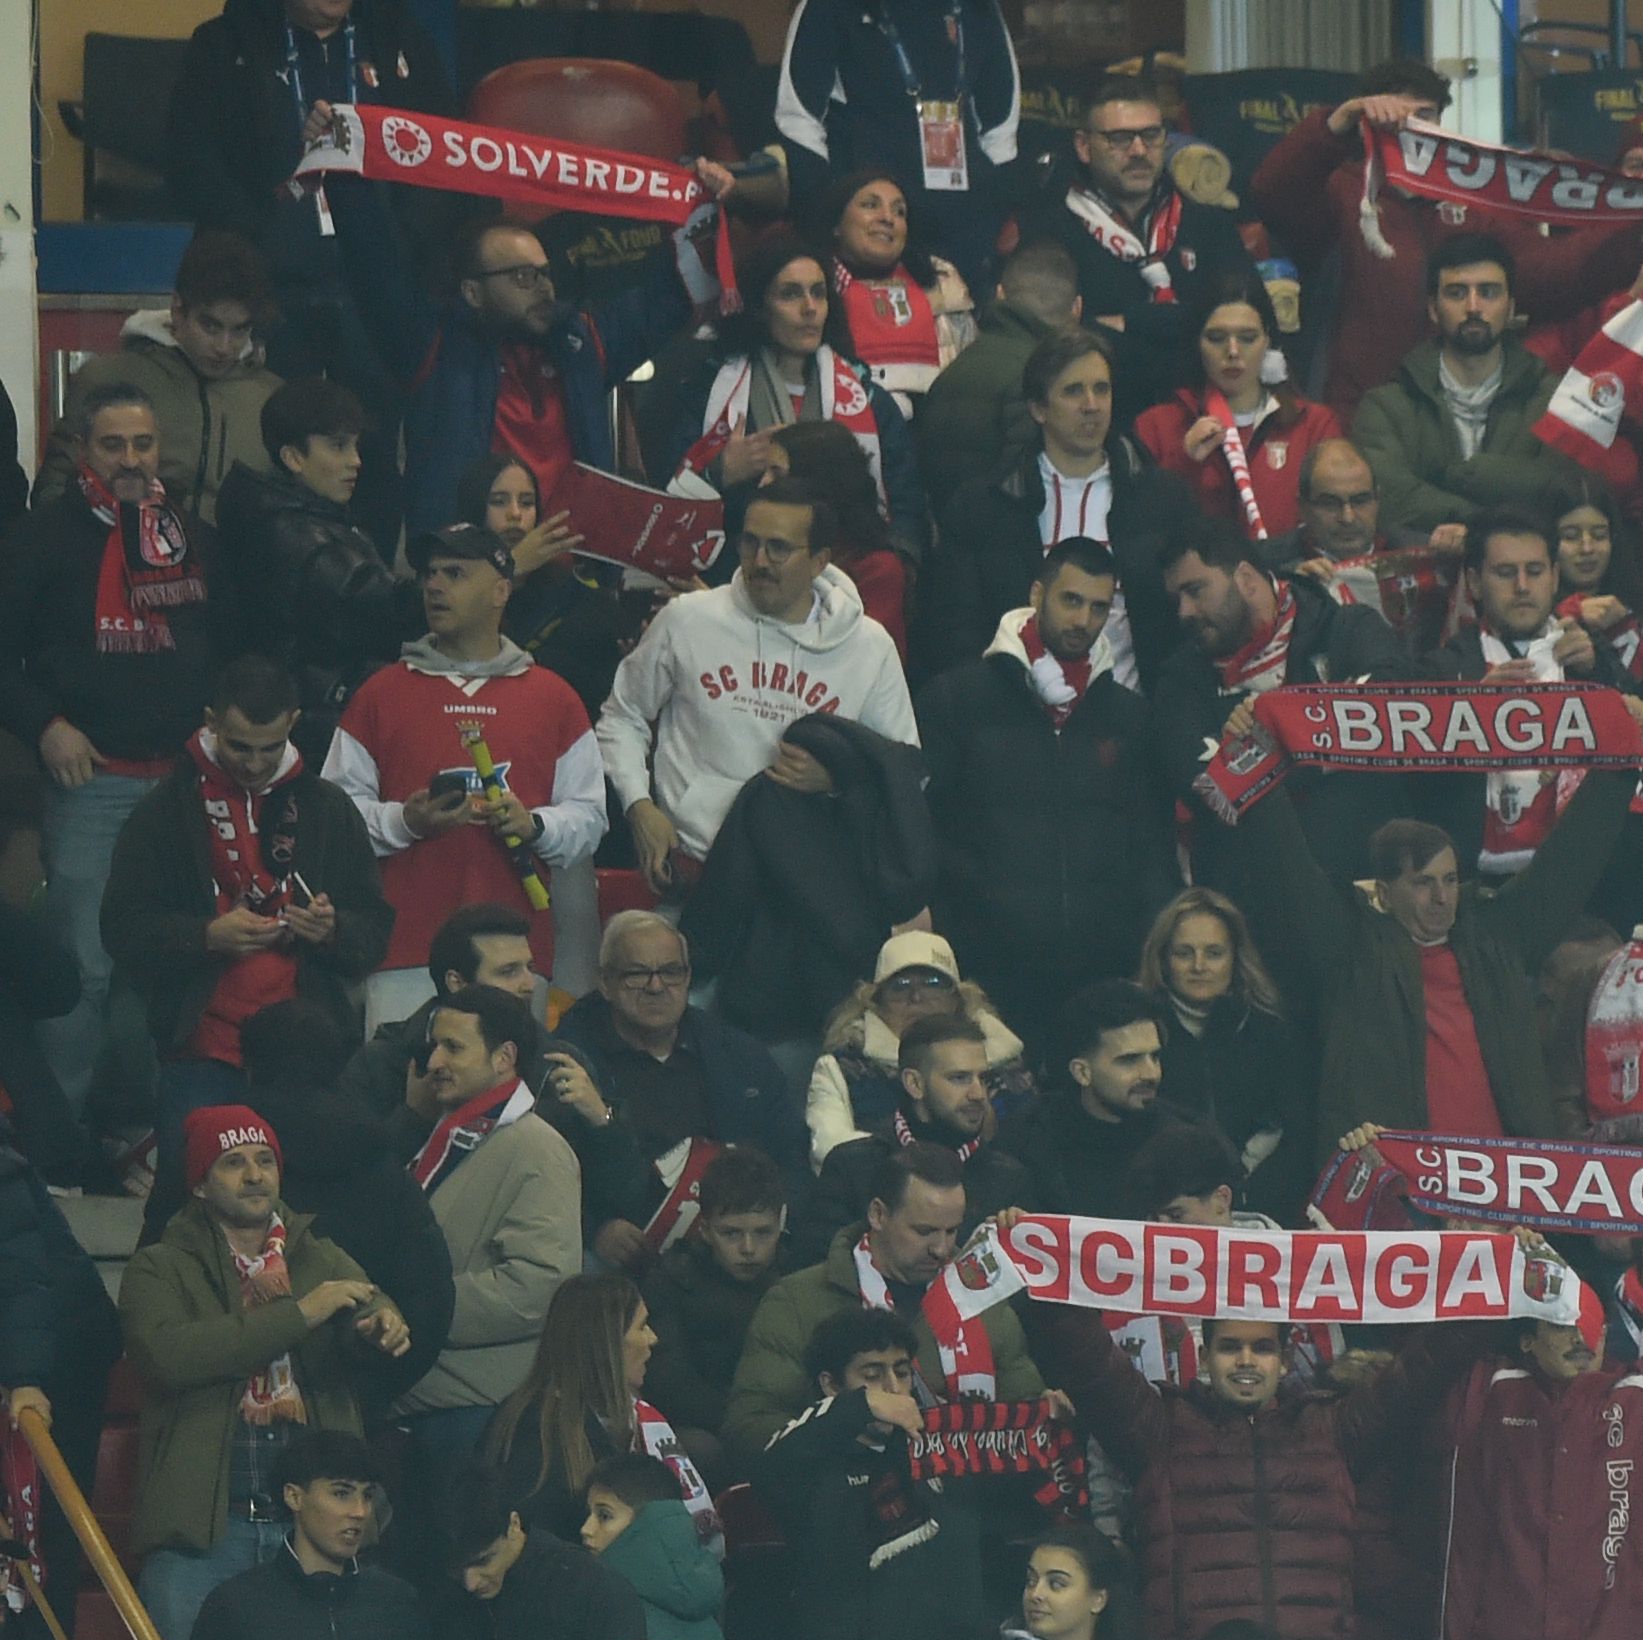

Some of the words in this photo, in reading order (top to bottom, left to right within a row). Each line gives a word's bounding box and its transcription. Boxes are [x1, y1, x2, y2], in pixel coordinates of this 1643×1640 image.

[442, 130, 702, 203] SOLVERDE.P
[443, 704, 498, 715] UMBRO
[699, 664, 738, 700] SC
[752, 661, 841, 716] BRAGA
[1332, 696, 1598, 752] BRAGA
[218, 1126, 268, 1150] BRAGA
[1540, 1142, 1575, 1153] BRAGA
[1415, 1146, 1444, 1195] S.C.
